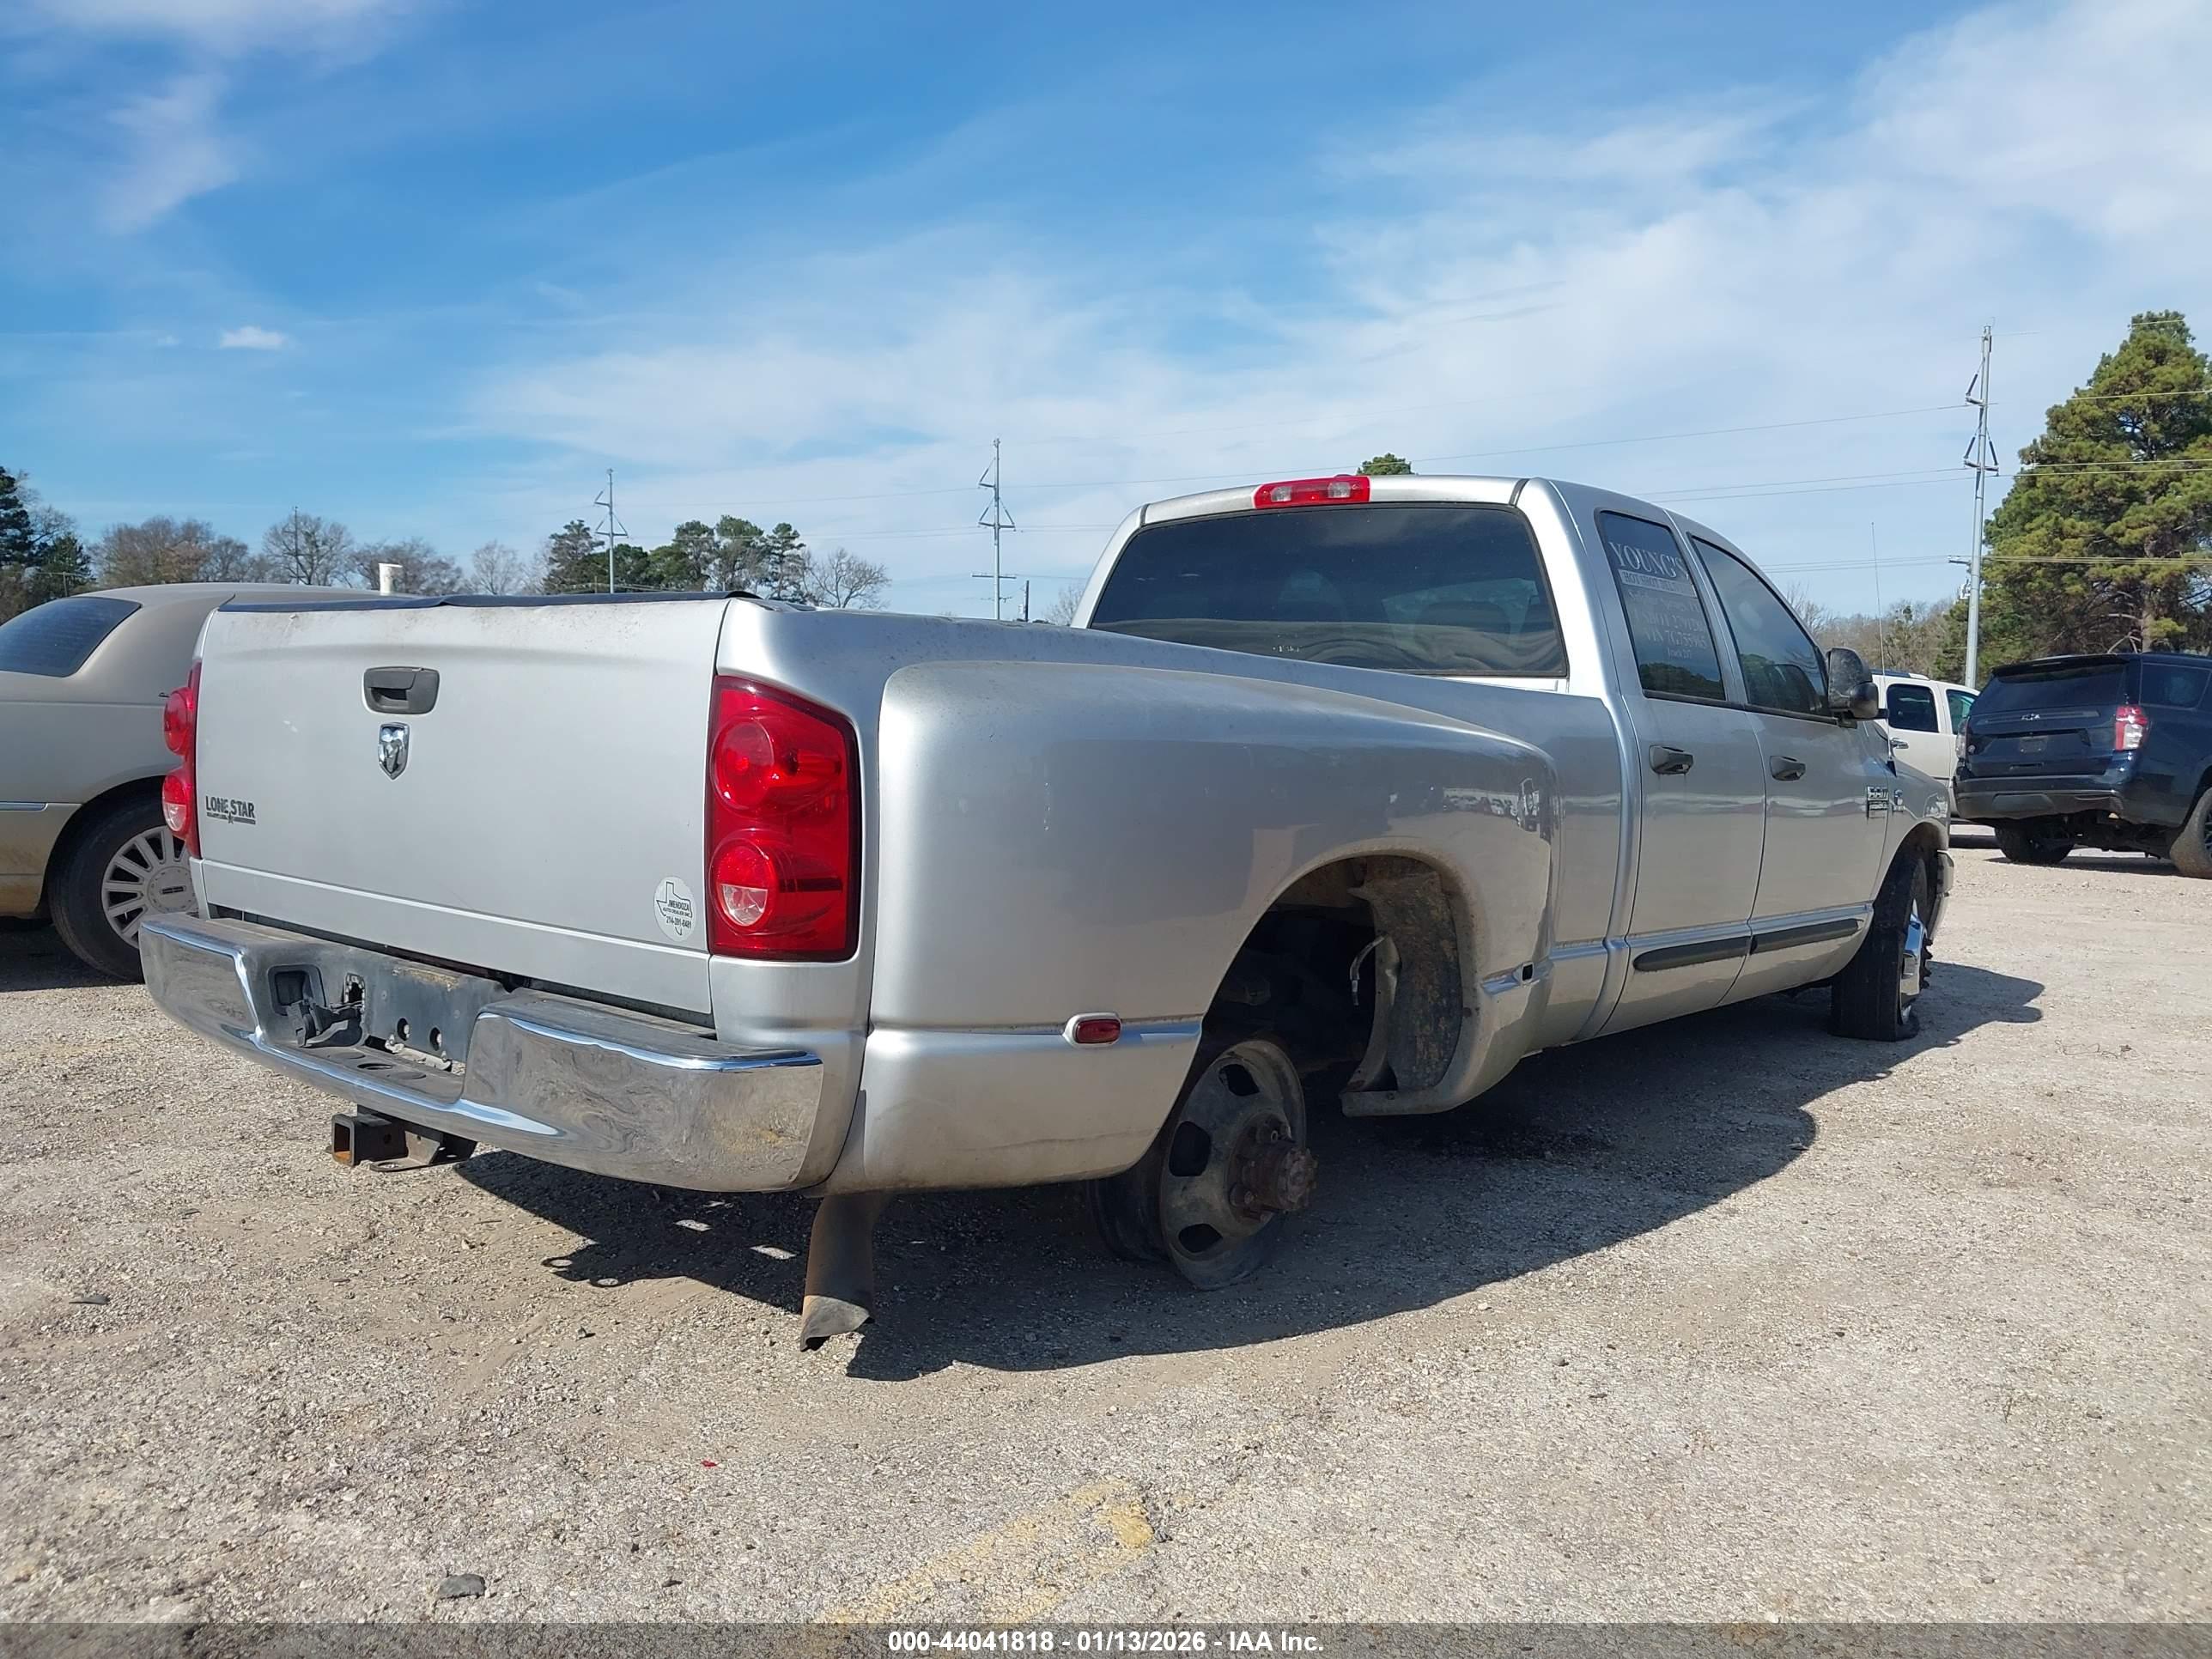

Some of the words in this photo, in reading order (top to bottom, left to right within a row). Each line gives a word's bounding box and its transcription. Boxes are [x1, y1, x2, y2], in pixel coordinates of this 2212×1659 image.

[1608, 542, 1688, 580] YOUNG'S
[205, 795, 228, 813] LONE
[230, 799, 255, 817] STAR
